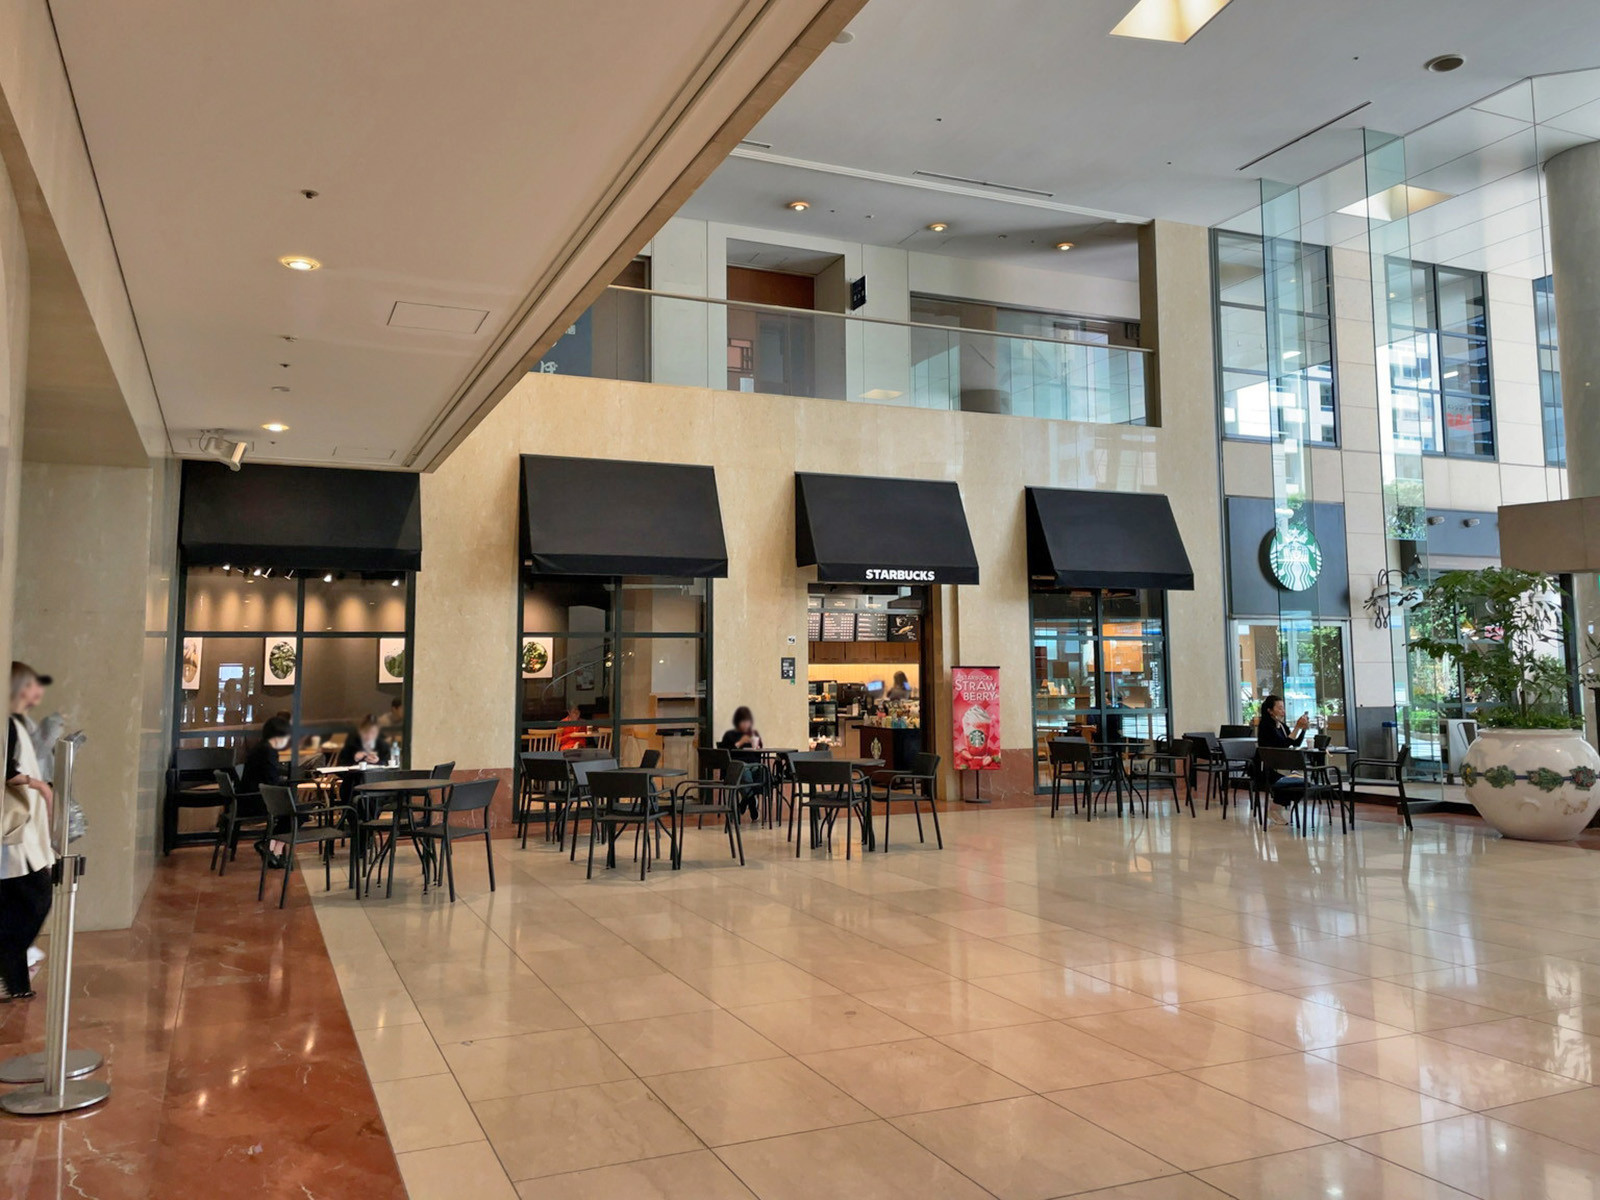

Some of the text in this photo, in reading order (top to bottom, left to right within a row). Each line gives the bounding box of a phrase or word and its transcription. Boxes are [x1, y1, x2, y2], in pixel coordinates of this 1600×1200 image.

[865, 569, 935, 581] STARBUCKS
[955, 679, 997, 691] STRAW
[963, 691, 996, 701] BERRY
